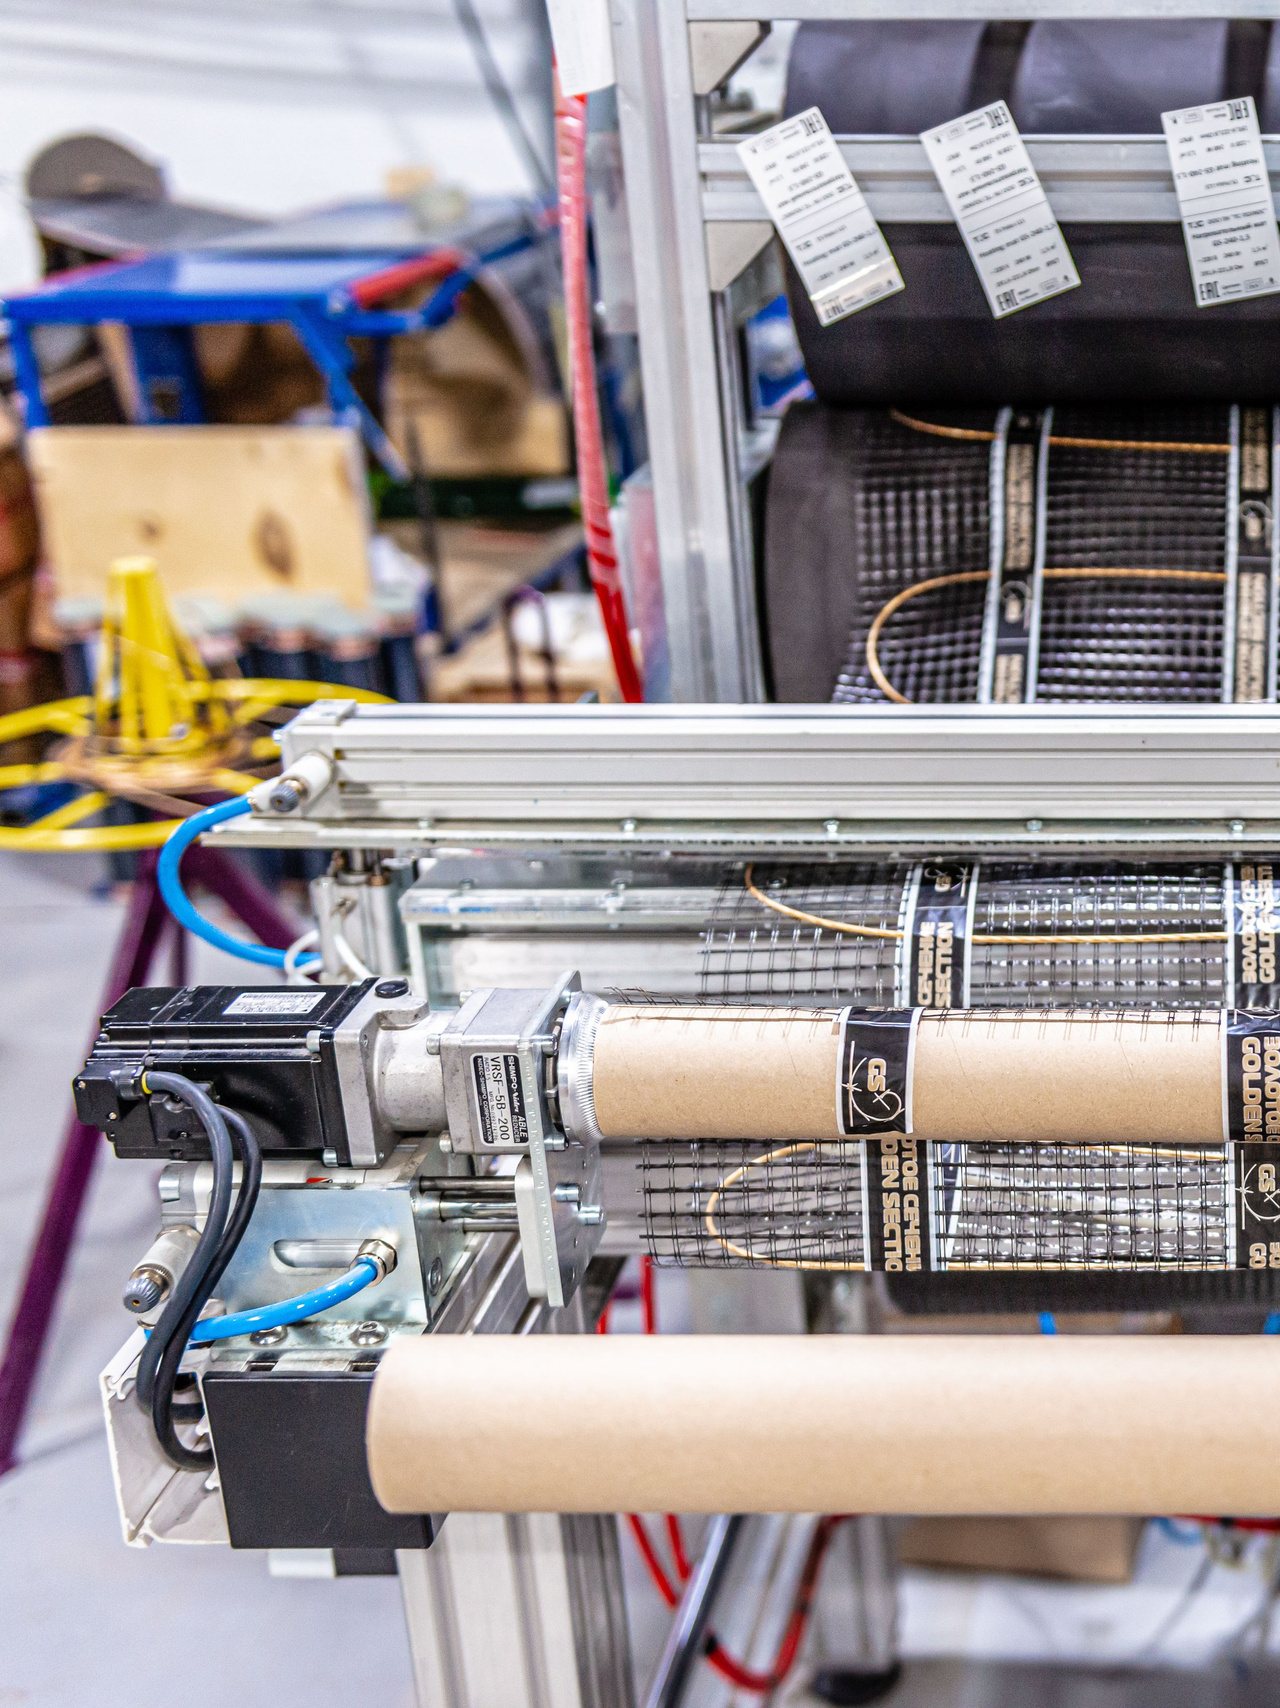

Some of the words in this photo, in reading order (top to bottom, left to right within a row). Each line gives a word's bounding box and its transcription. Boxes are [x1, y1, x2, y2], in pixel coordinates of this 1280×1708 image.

[995, 288, 1020, 311] EAC
[1199, 281, 1220, 300] EAC
[918, 922, 935, 1006] СЕЧЕНИЕ
[935, 922, 954, 1008] SECTION
[477, 1058, 487, 1099] NIDEC-SHIMPO
[483, 1100, 492, 1142] CORPORATION
[490, 1056, 510, 1140] VRSF-5B-200
[867, 1058, 887, 1092] GS
[1242, 1037, 1262, 1132] GOLDEN
[512, 1115, 520, 1142] REDUCER
[518, 1115, 527, 1138] ABLE
[881, 1139, 900, 1188] DEN
[901, 1139, 919, 1191] ОТОЕ
[1258, 1163, 1276, 1193] GS
[882, 1192, 903, 1272] SECTIO
[903, 1194, 921, 1272] СЕЧЕНИ
